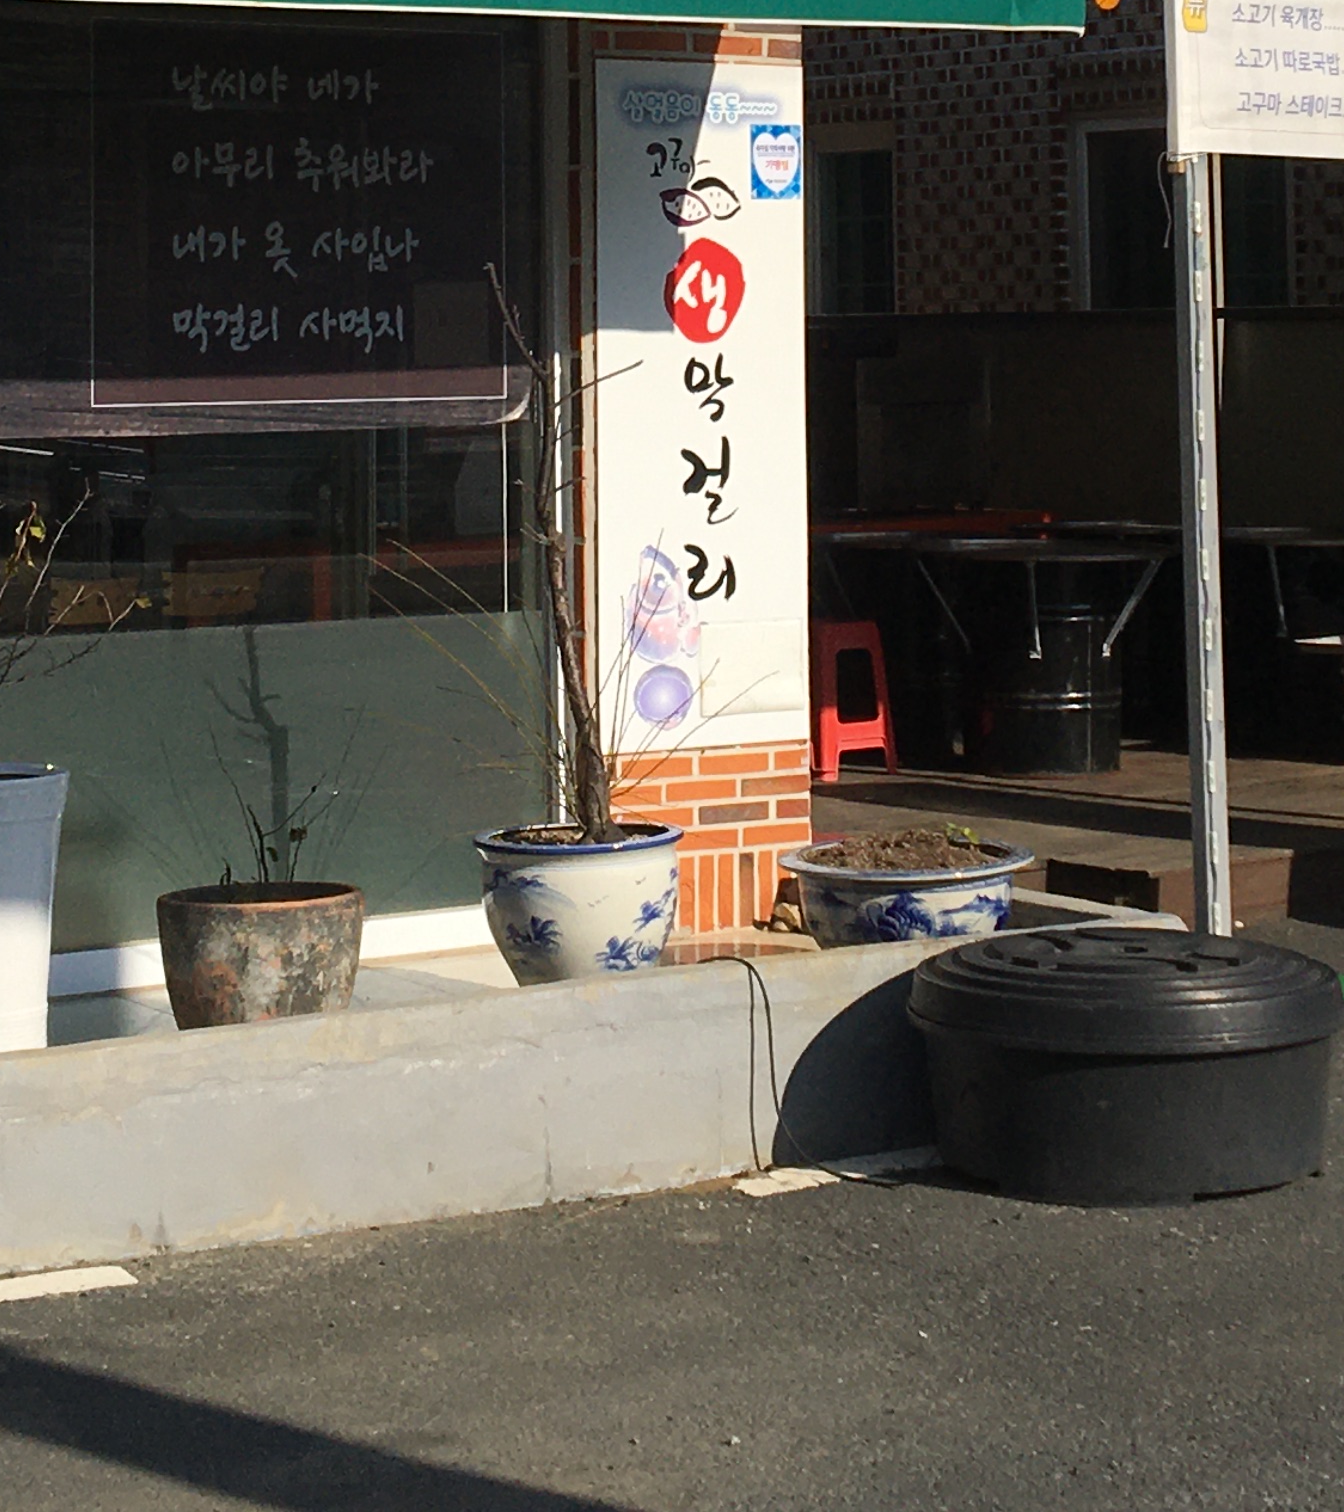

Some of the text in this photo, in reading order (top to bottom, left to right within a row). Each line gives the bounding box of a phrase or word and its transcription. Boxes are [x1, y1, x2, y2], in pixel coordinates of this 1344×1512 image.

[1232, 3, 1277, 28] 소고기
[1280, 5, 1324, 32] 육개장
[1234, 47, 1279, 72] 소고기
[1282, 50, 1341, 76] 따로국밥
[171, 64, 380, 110] 날씨야 네가
[1236, 92, 1282, 116] 고구마
[1284, 94, 1343, 119] 스테이크
[171, 136, 435, 192] 아무리 추워봐라
[171, 220, 420, 278] 내가 옷 사입나
[171, 303, 406, 354] 막걸리 사먹지
[673, 260, 739, 602] 생 막걸리
